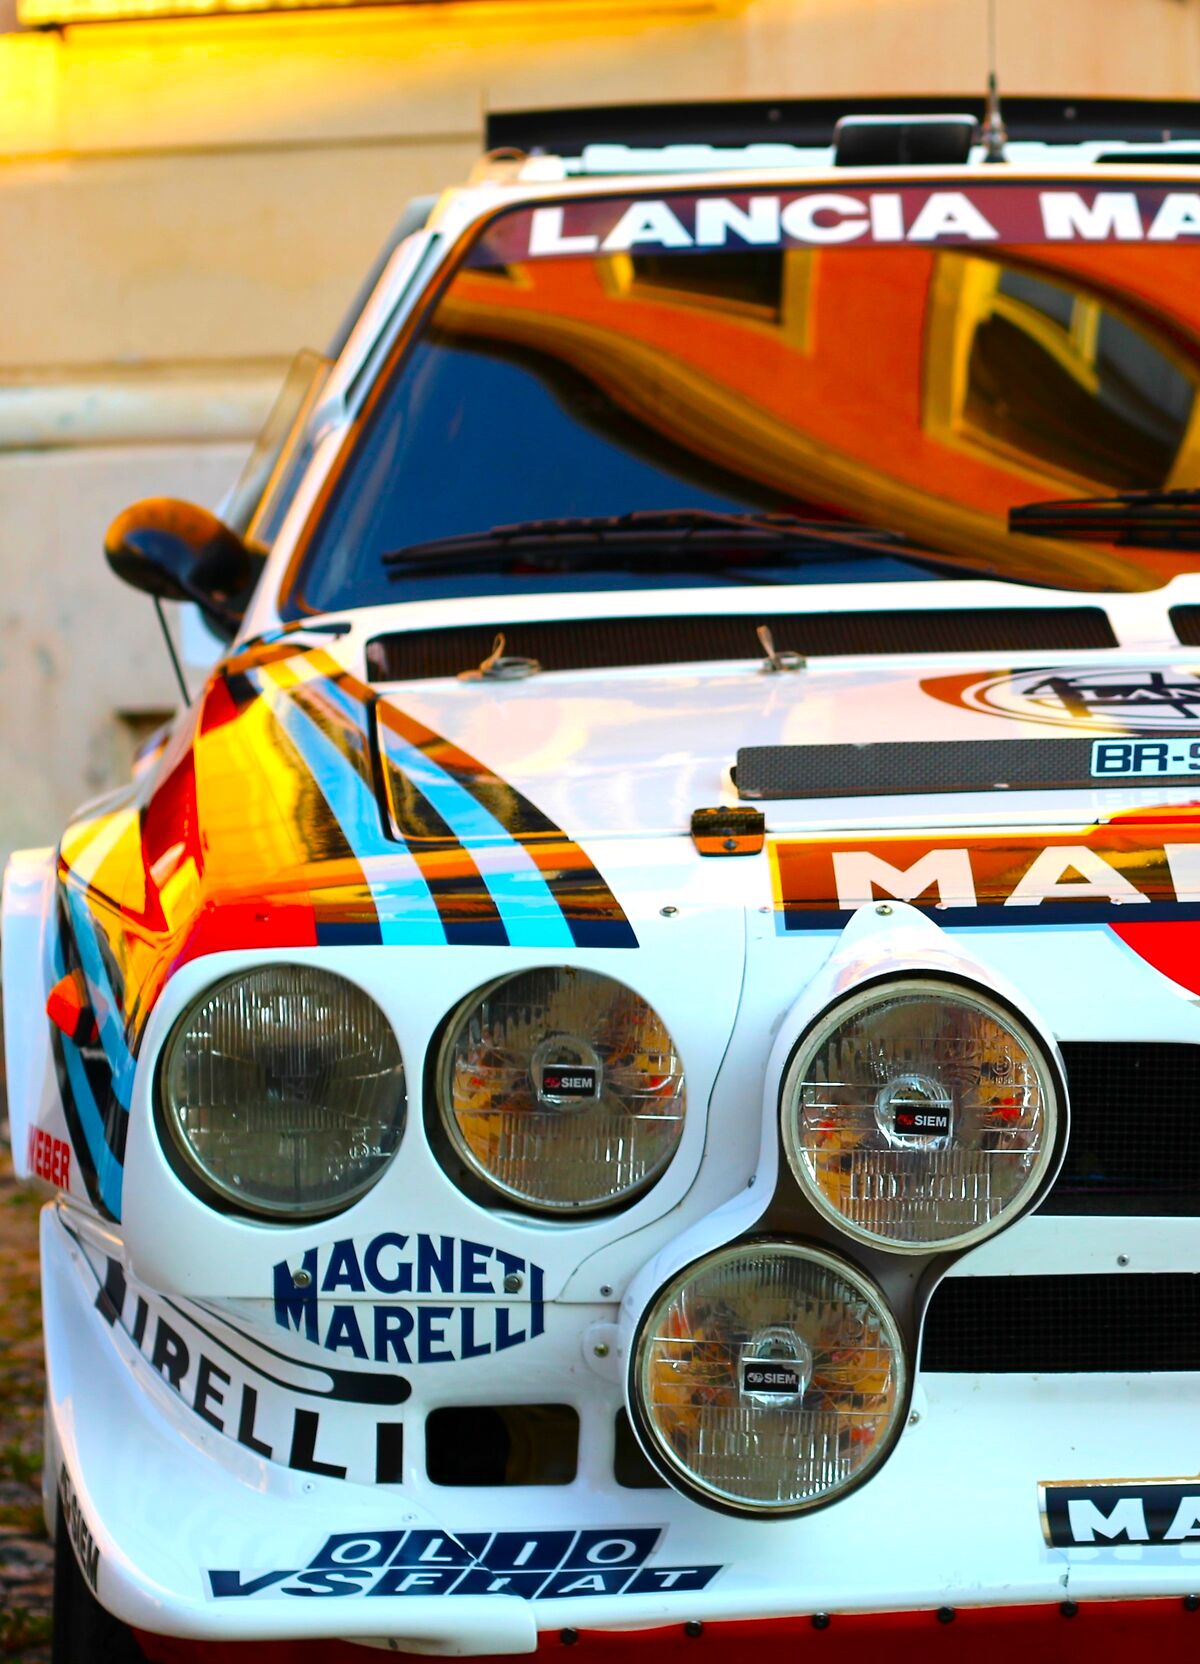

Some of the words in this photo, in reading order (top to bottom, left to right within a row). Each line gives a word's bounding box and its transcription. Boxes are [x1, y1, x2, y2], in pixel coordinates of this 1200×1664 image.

[528, 192, 999, 256] LANCIA
[561, 1077, 593, 1088] SIEM
[914, 1115, 947, 1127] SIEM
[272, 1232, 545, 1298] MAGNETI
[273, 1297, 545, 1364] MARELLI
[764, 1372, 797, 1384] SIEM
[328, 1537, 638, 1568] OLIO
